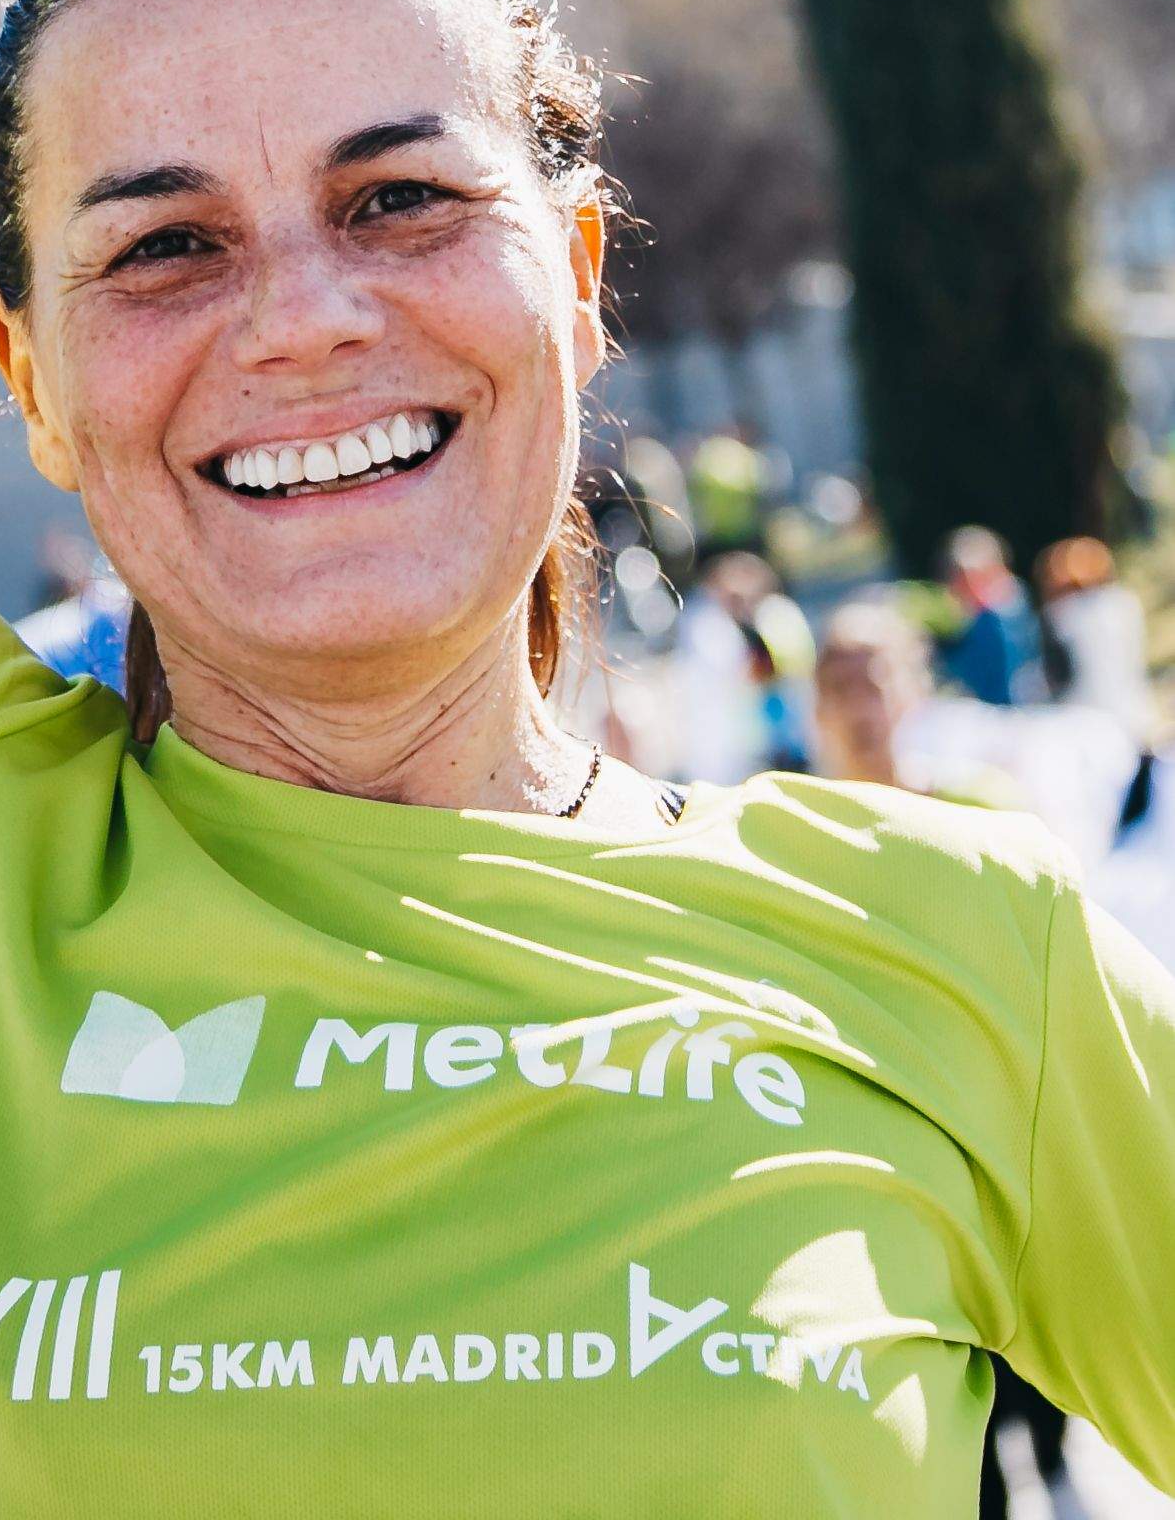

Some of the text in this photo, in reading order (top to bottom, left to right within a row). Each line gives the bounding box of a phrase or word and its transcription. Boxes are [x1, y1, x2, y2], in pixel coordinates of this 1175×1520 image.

[294, 997, 806, 1126] MetLife
[138, 1339, 316, 1394] 15KM
[342, 1331, 617, 1385] MADRID
